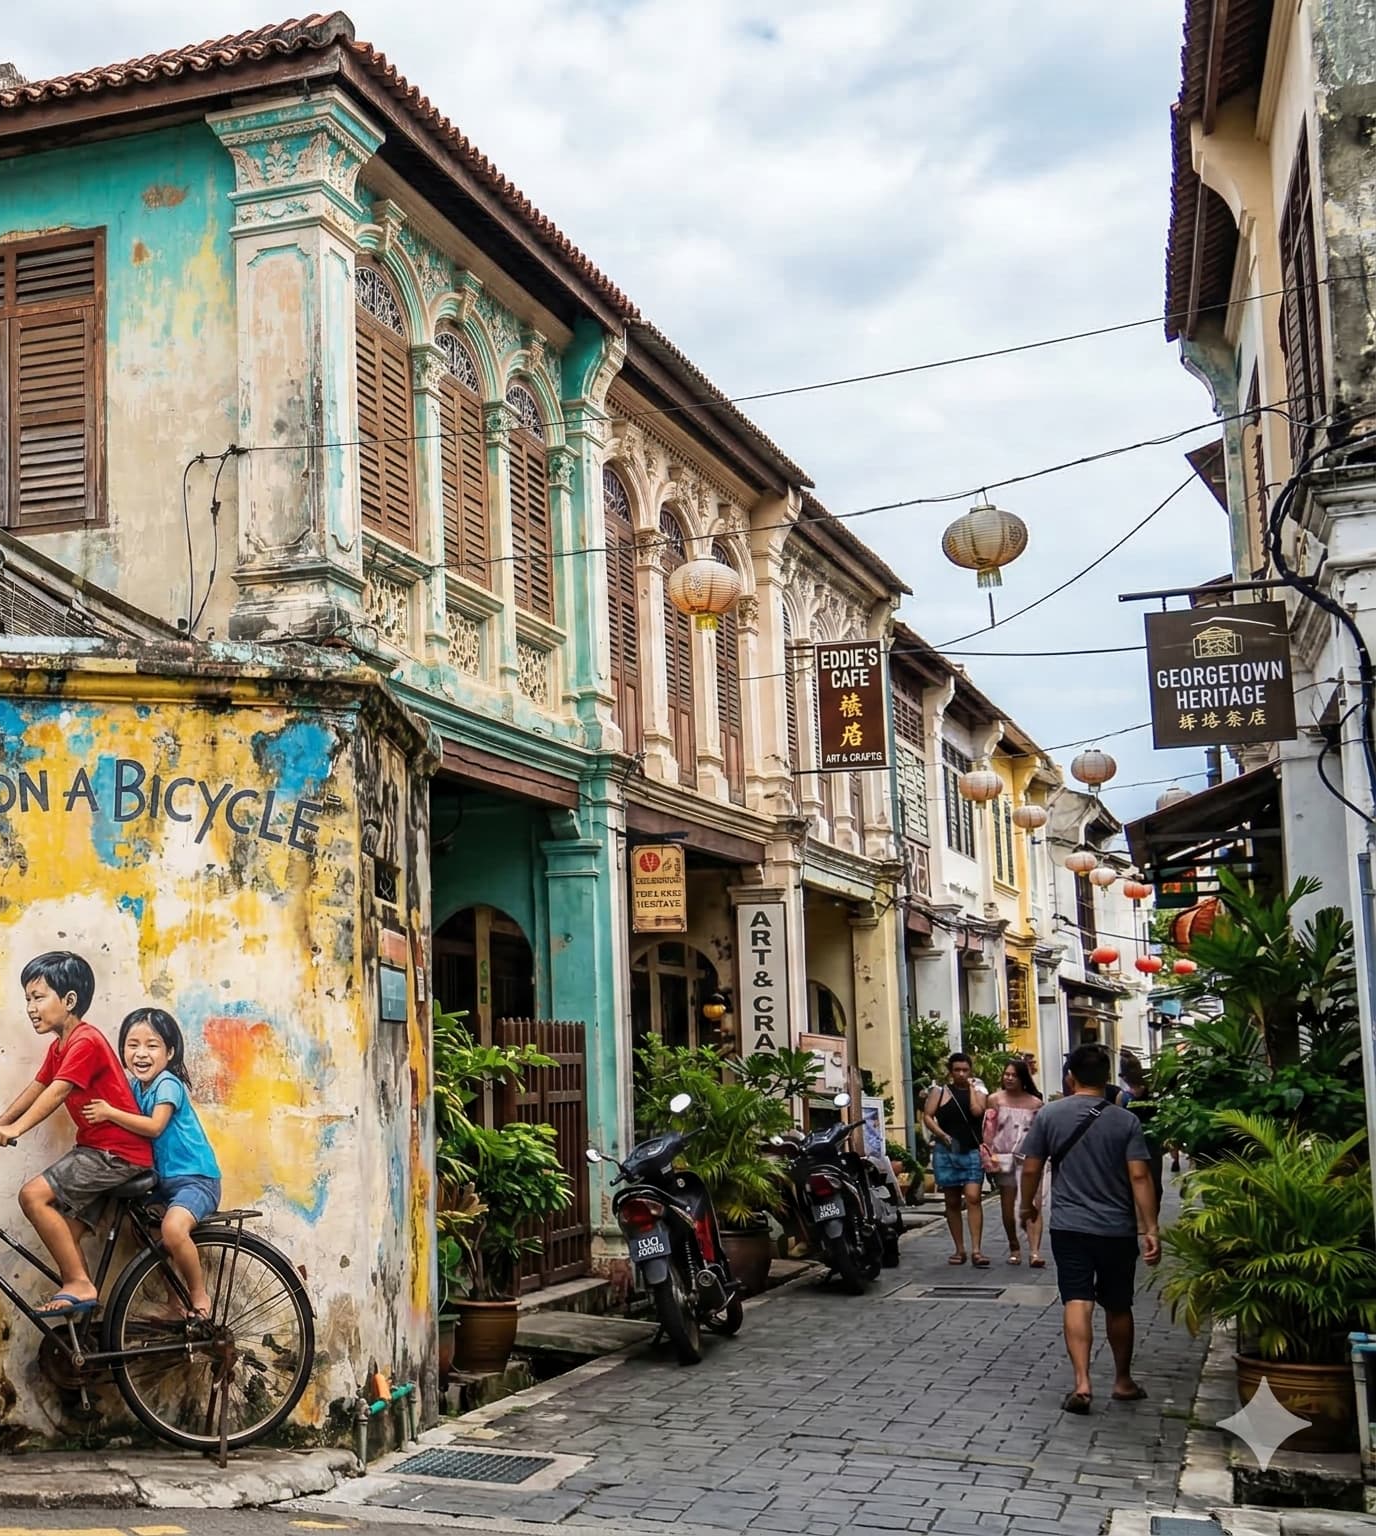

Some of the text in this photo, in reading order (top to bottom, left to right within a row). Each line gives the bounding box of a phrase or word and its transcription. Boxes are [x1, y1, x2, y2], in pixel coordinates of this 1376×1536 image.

[820, 648, 878, 669] EDDIE'S
[831, 668, 870, 688] CAFE
[1156, 660, 1284, 689] GEORGETOWN
[1176, 684, 1267, 710] HERITAGE
[825, 753, 840, 763] ART
[62, 767, 100, 813] A
[113, 758, 324, 854] BICYCLE
[750, 911, 772, 966] ART
[752, 970, 774, 988] &
